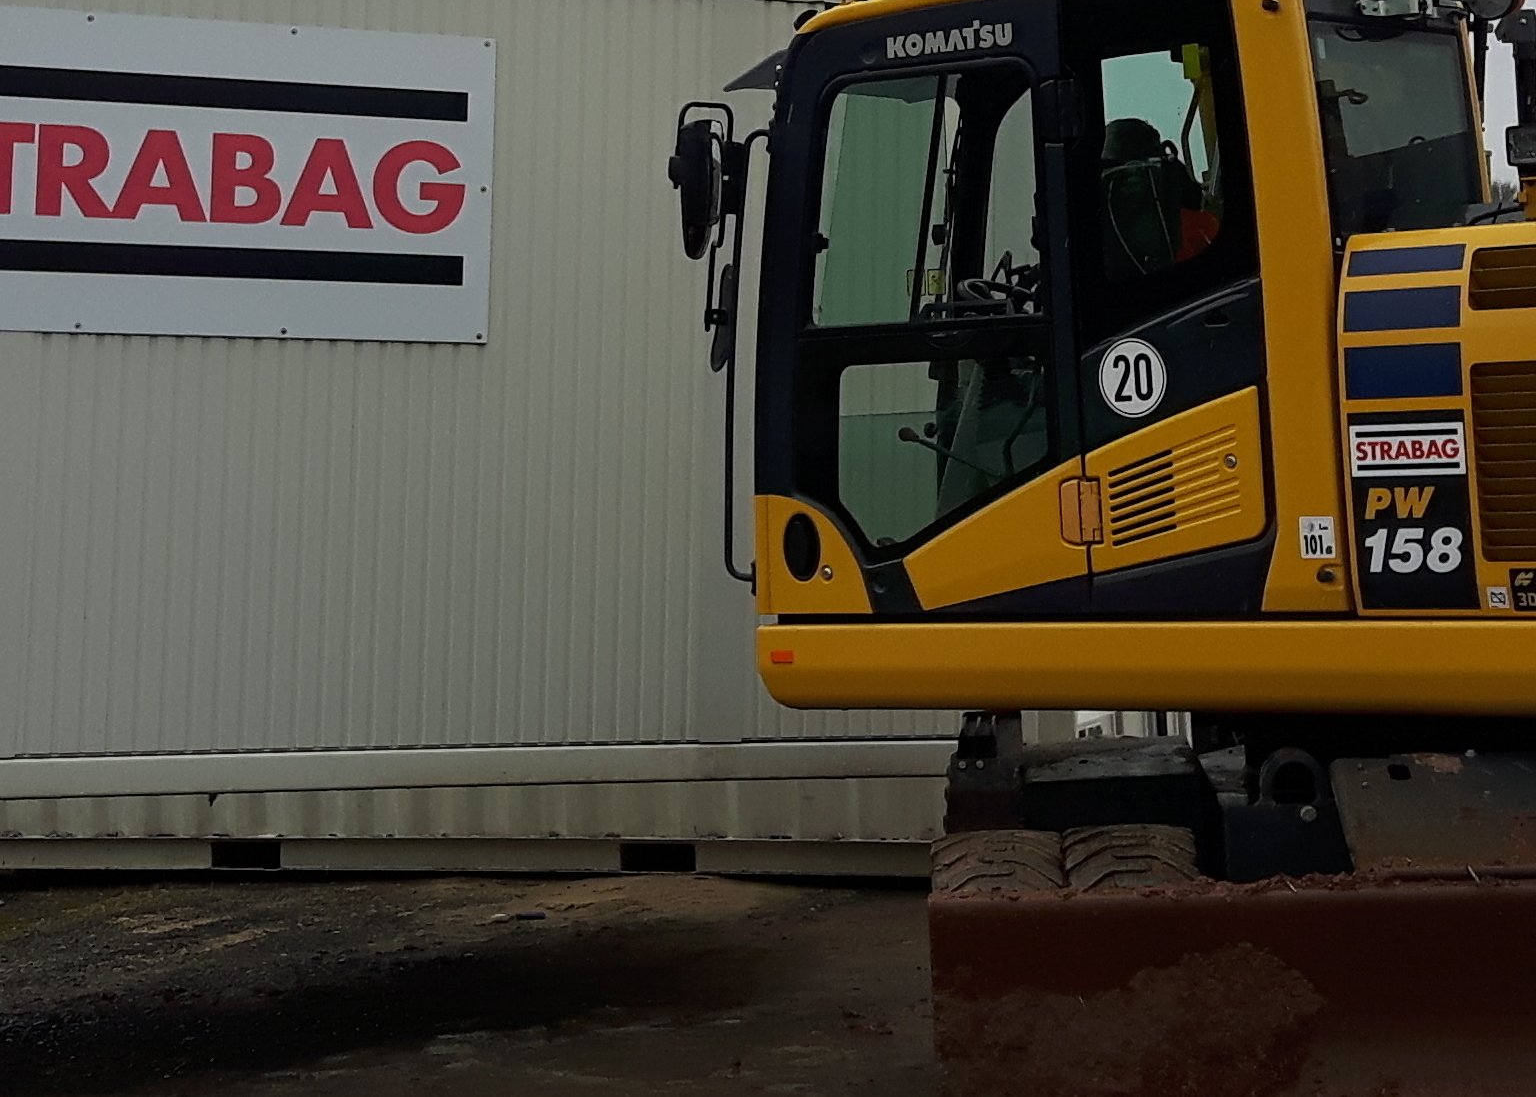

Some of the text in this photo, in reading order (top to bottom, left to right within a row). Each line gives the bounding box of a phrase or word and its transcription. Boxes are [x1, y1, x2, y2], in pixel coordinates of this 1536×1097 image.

[886, 20, 1013, 59] KOMATSU
[1112, 352, 1154, 403] 20
[1355, 438, 1460, 462] STRABAG
[1365, 486, 1436, 520] PW
[1304, 534, 1324, 555] 101
[1364, 526, 1463, 574] 158
